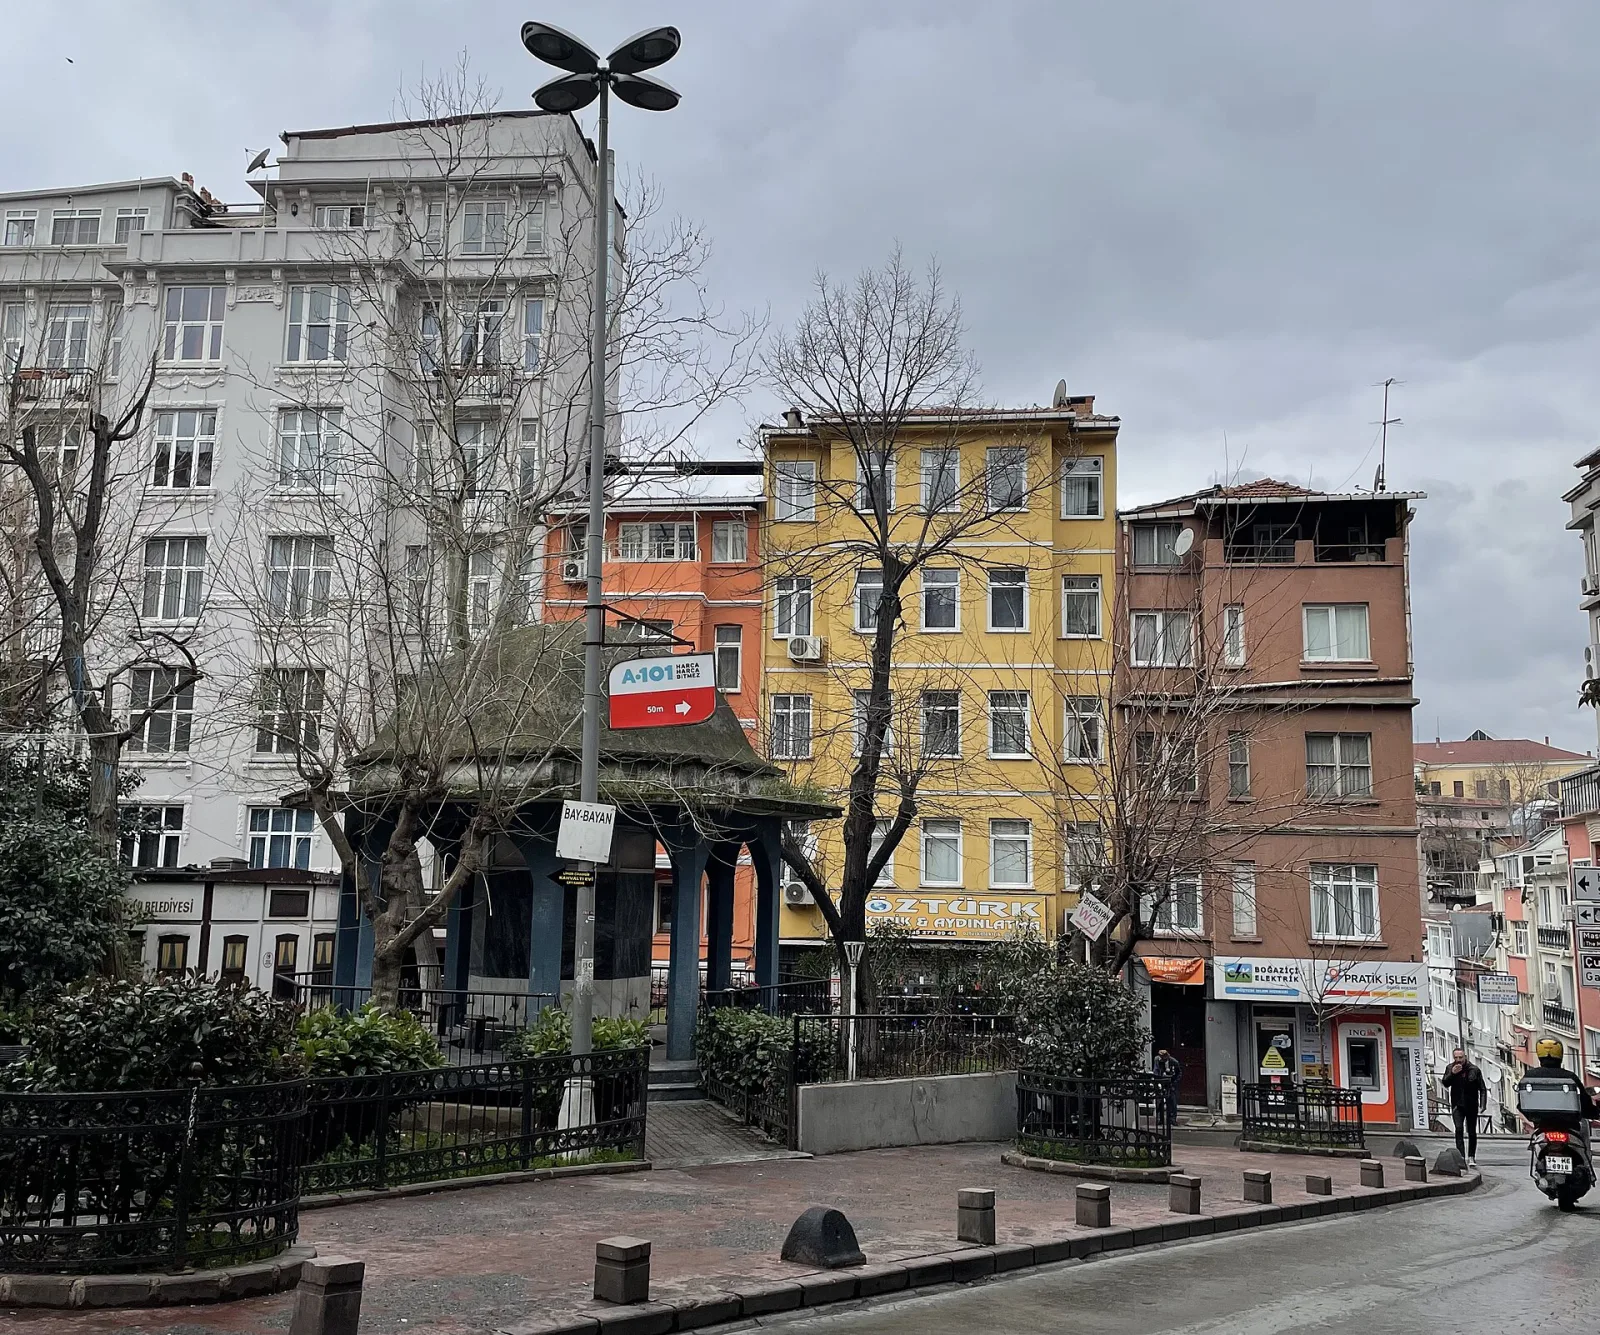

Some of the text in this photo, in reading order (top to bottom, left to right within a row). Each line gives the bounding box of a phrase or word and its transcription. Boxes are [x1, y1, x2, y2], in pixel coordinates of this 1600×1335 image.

[647, 705, 664, 713] 50m
[564, 807, 613, 824] BAY-BAYAN
[145, 897, 193, 914] BELEDİYESİ
[865, 896, 1042, 917] ÖZTÜRK
[1084, 897, 1110, 921] BAY-BAYAN
[1079, 907, 1098, 927] WC
[1583, 932, 1600, 940] Mas
[1254, 966, 1299, 975] BOĞAZİÇİ
[1254, 975, 1299, 983] ELEKTRİK
[1344, 972, 1417, 985] PRATİK İŞLEM
[1413, 1048, 1425, 1126] FATURA ÖDEME NOKTASI
